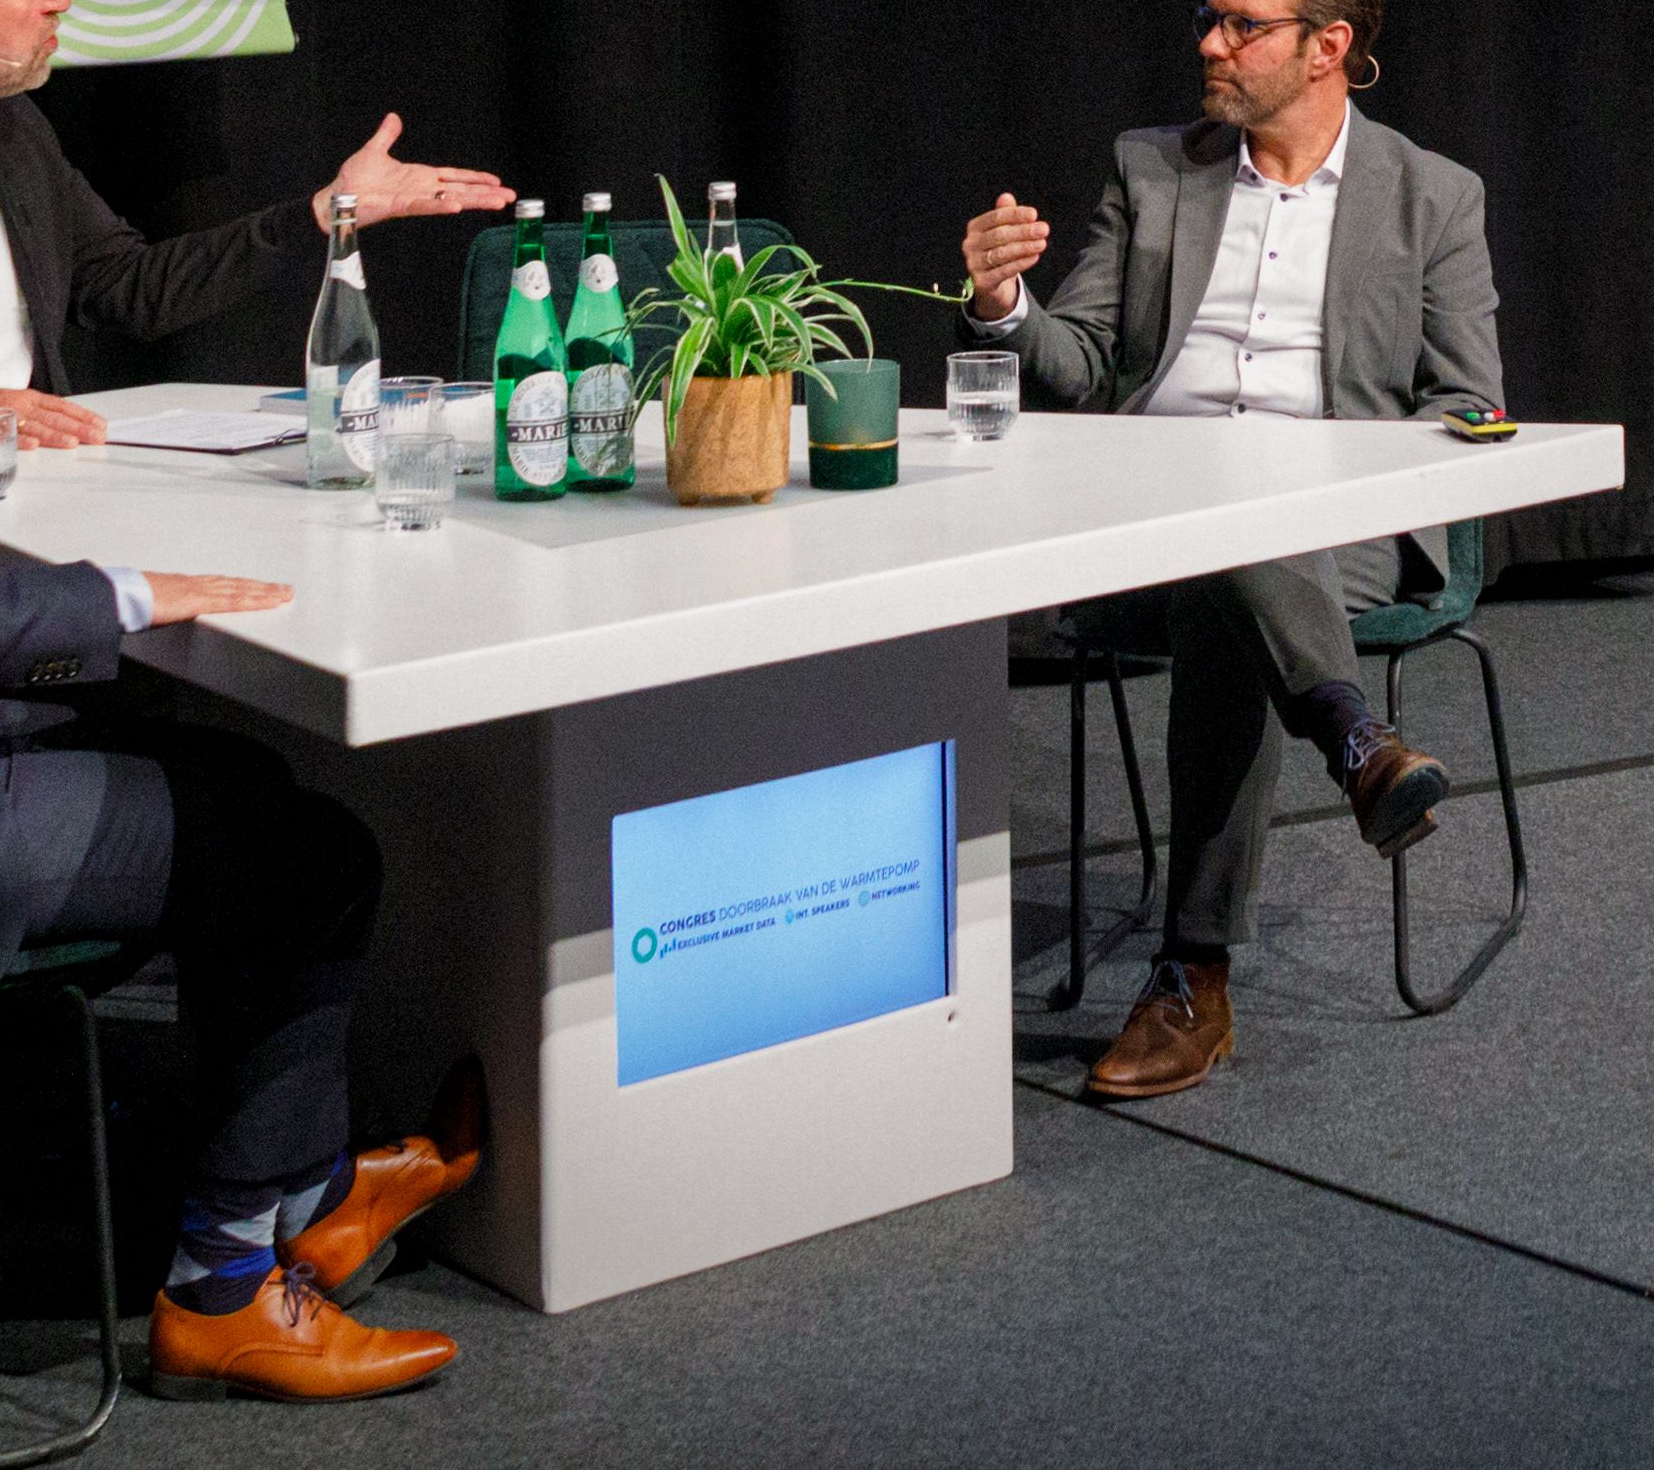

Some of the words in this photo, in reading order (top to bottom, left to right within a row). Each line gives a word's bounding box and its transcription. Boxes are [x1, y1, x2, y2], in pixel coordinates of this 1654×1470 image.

[660, 909, 716, 935] CONGRES
[719, 891, 792, 921] DOORBRAAK
[796, 883, 819, 901] VAN
[821, 879, 837, 896] DE
[840, 859, 920, 891] WARMTEPOMP
[677, 931, 720, 950] EXCLUSIVE
[722, 922, 754, 939] MARKET
[756, 917, 776, 931] DATA
